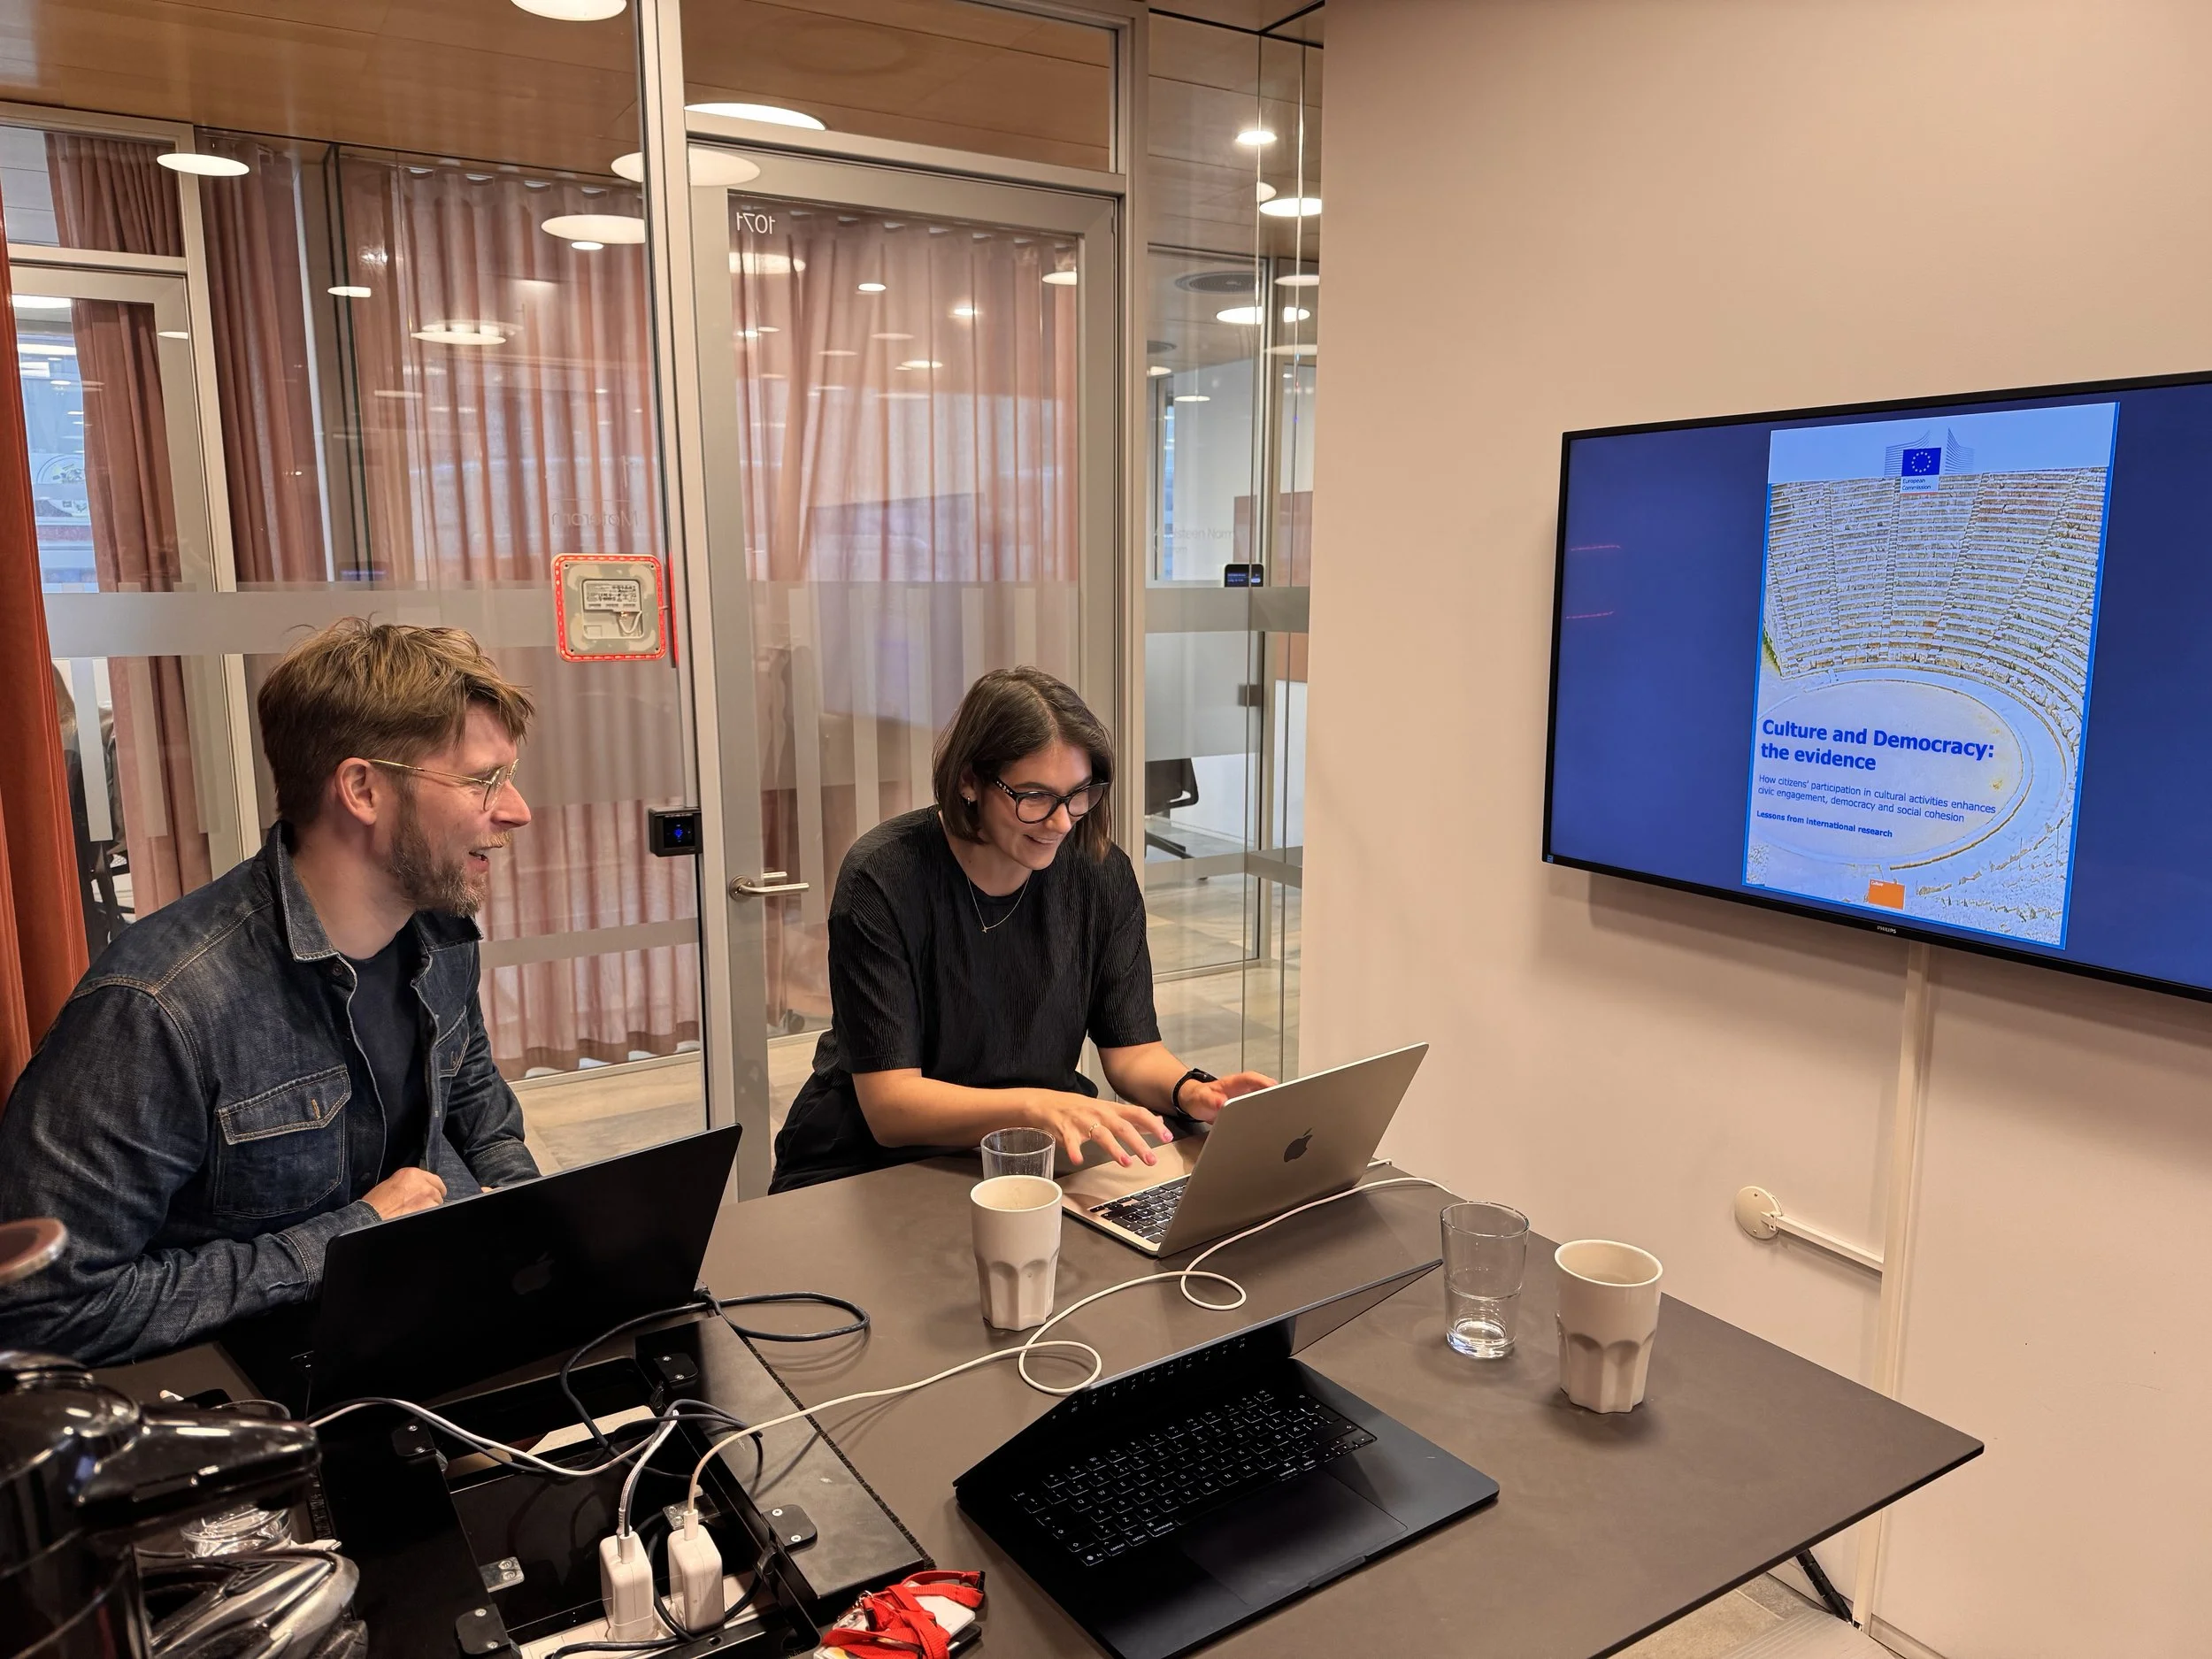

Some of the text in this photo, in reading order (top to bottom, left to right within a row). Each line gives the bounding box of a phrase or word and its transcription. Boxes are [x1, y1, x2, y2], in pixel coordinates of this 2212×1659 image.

[1763, 719, 1993, 761] Culture and Democracy:
[1761, 742, 1876, 771] the evidence
[1758, 787, 1964, 823] civic engagement, democracy and social cohesion
[1759, 774, 1776, 784] How
[1810, 782, 1861, 796] participation
[1863, 787, 1871, 797] in
[1874, 790, 1906, 802] cultural
[1909, 795, 1948, 808] activities
[1951, 800, 1996, 814] enhances
[1756, 810, 1786, 821] Lessons
[1786, 814, 1804, 825] from
[1858, 825, 1893, 838] research
[1877, 925, 1897, 934] PHILIPS
